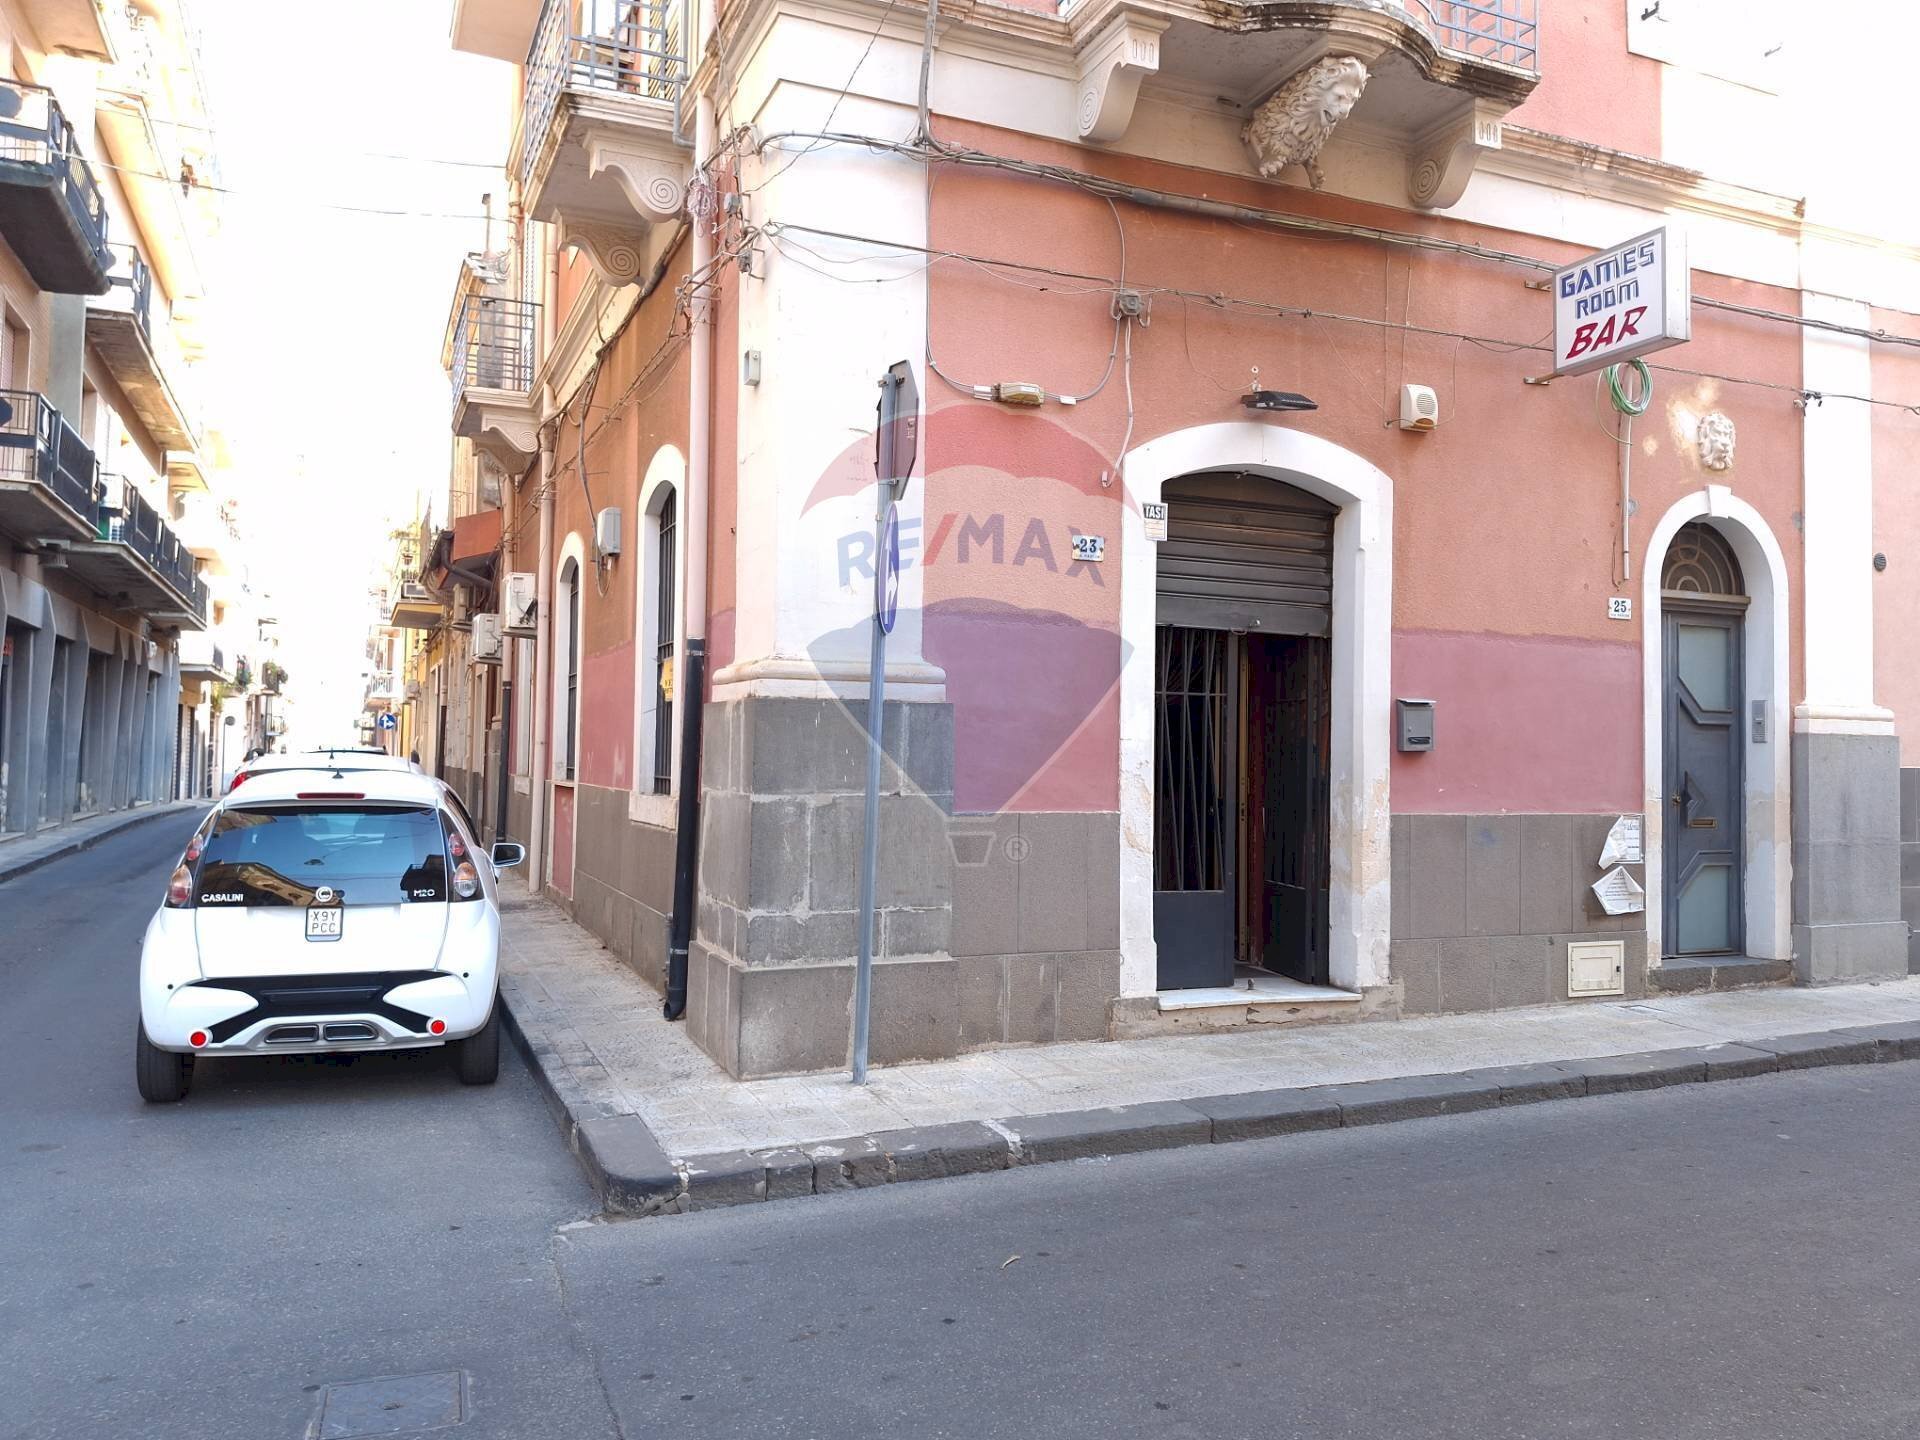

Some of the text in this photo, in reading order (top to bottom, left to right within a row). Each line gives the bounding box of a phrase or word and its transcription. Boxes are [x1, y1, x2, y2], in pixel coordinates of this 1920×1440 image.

[1559, 239, 1655, 299] GAMES
[1575, 277, 1640, 319] ROOM
[1565, 305, 1648, 360] BAR
[1079, 538, 1097, 553] 23
[1613, 600, 1627, 613] 25
[201, 892, 244, 903] CASALINI
[313, 911, 337, 921] X9Y
[311, 922, 336, 933] PCC
